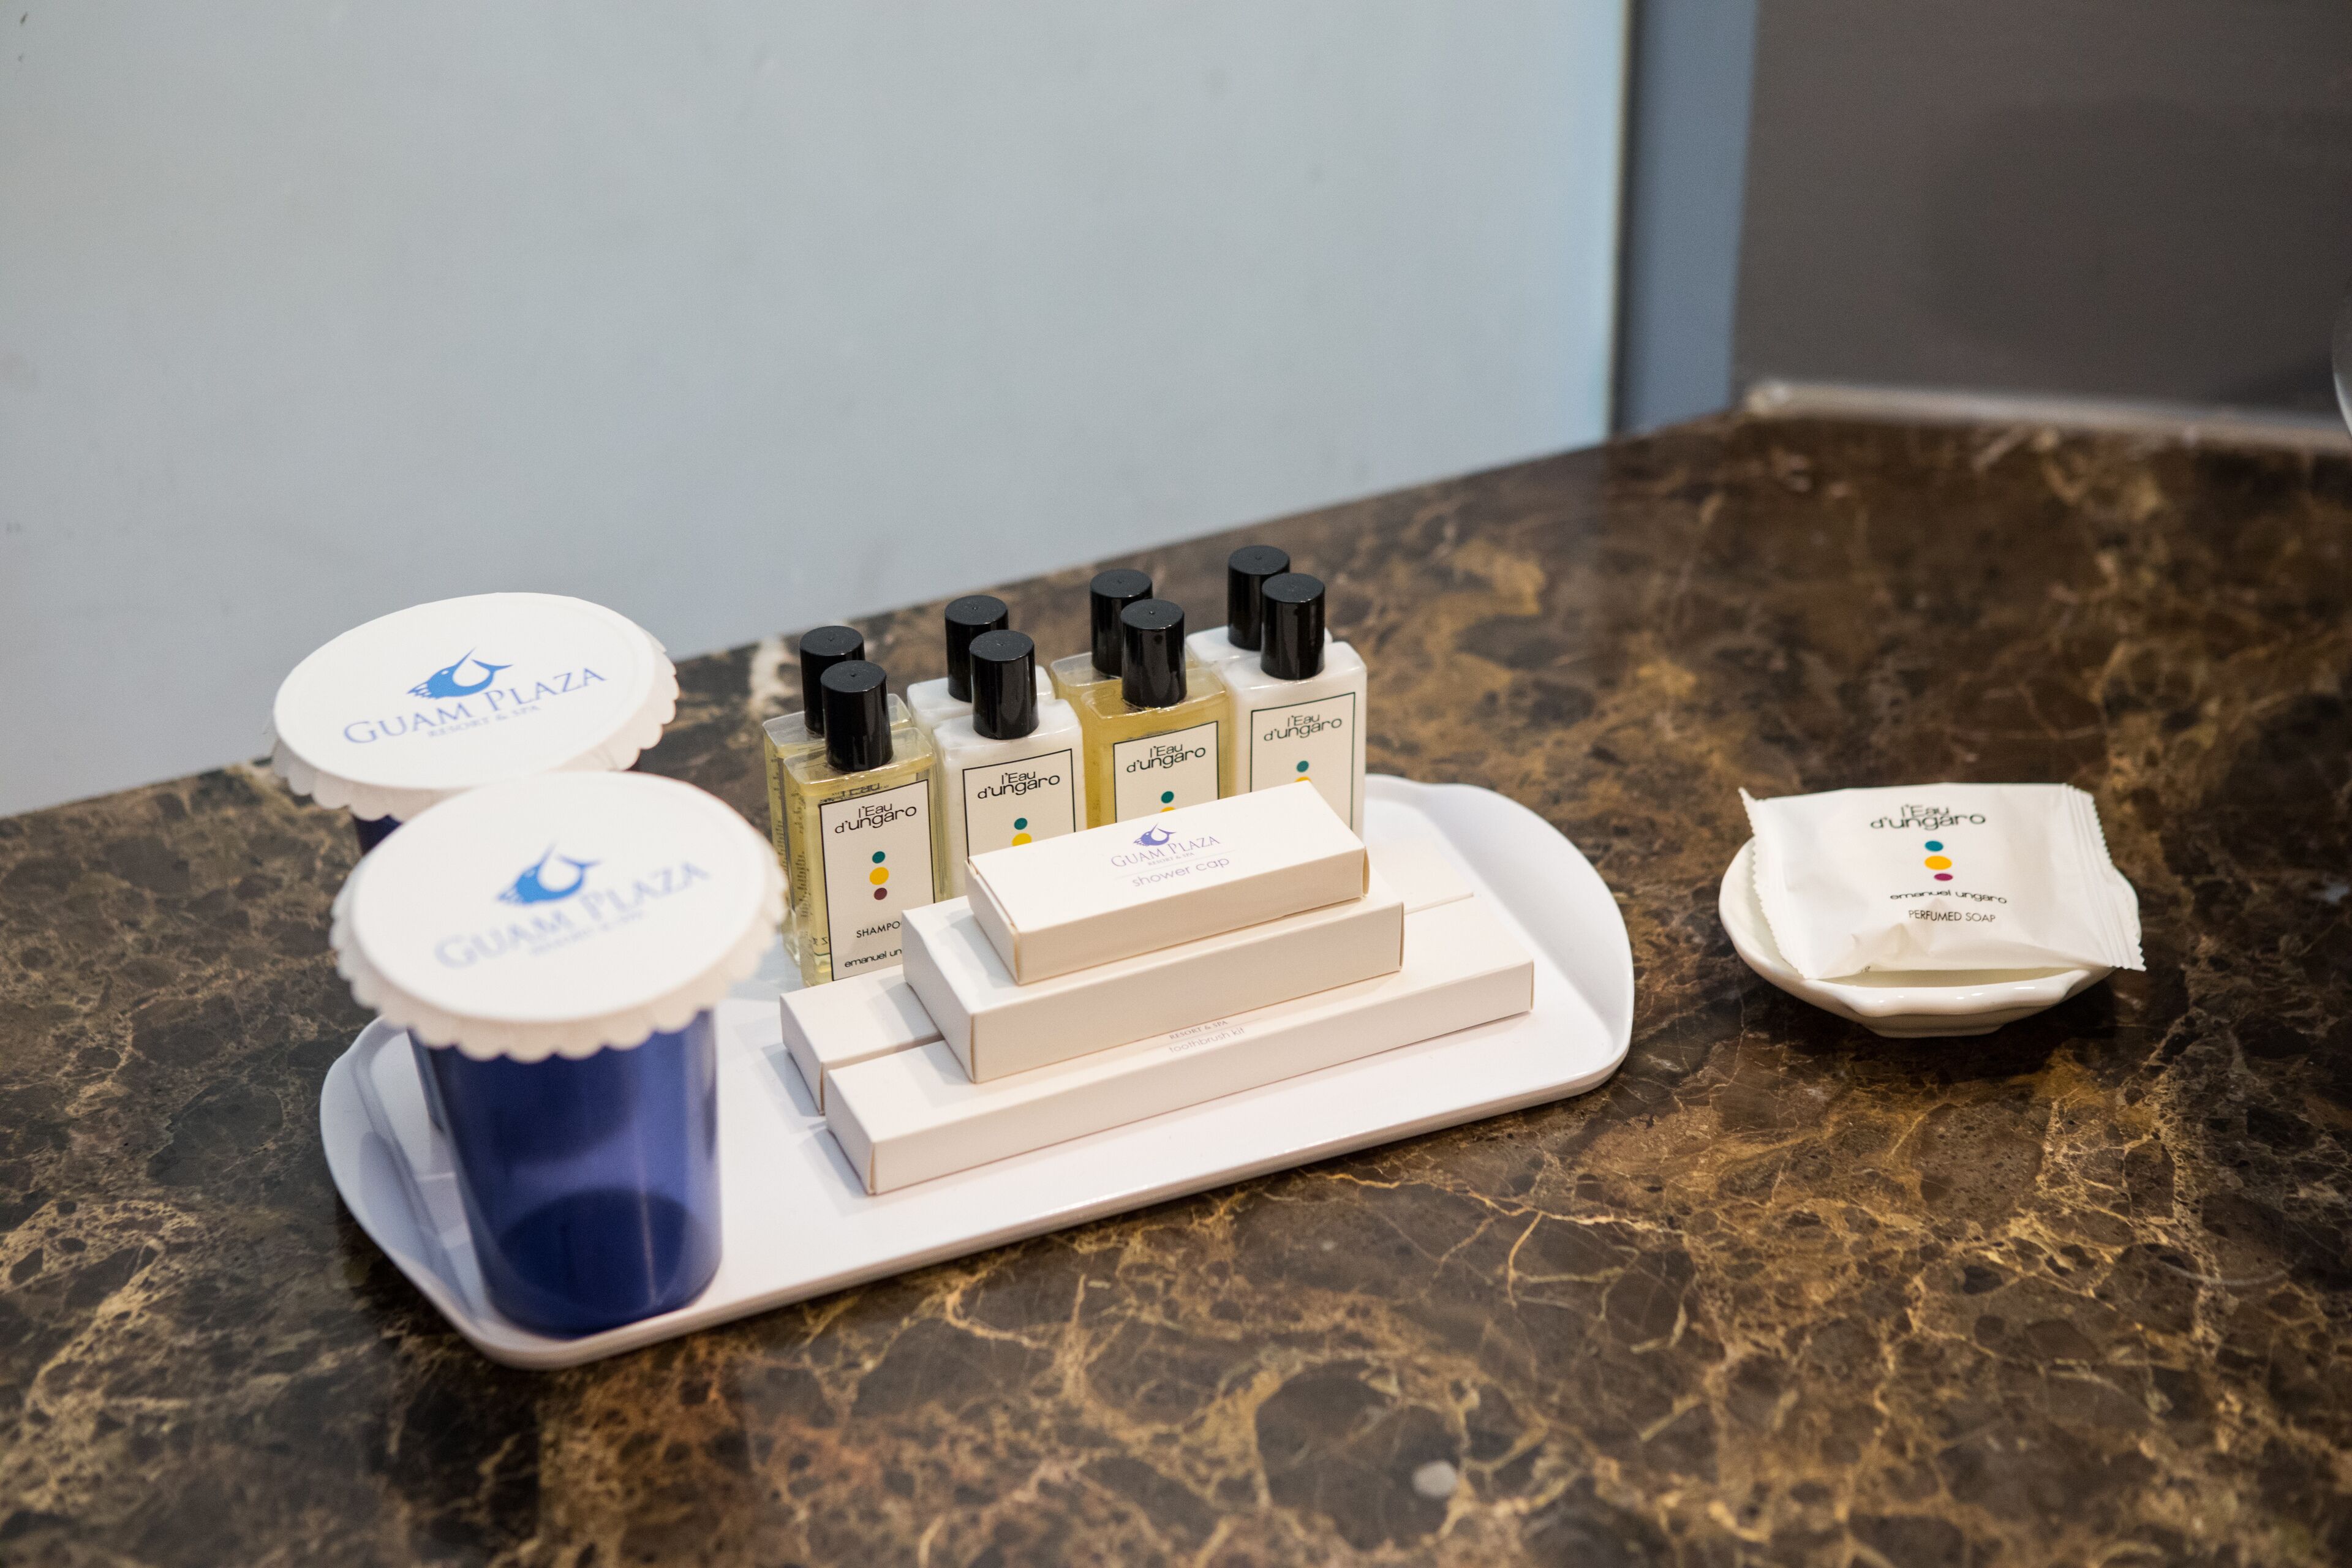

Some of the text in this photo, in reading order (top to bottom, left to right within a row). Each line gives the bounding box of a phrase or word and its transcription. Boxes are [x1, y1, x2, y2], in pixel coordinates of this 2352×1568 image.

[344, 667, 607, 744] GUAM PLAZA
[1287, 714, 1320, 727] l'Eau
[1264, 718, 1343, 741] d'ungaro
[1150, 744, 1183, 758] l'Eau
[1126, 747, 1206, 773] d'ungaro
[1001, 771, 1036, 785] l'Eau
[977, 775, 1060, 799] d'ungaro
[858, 803, 892, 818] l'Eau
[1901, 804, 1950, 817] l'Eau
[834, 806, 917, 834] d'ungaro
[1870, 813, 1986, 831] d'ungaro
[1111, 836, 1221, 867] GUAM PLAZA
[1132, 858, 1230, 888] shower cap
[1890, 889, 2007, 904] emanuel ungaro
[434, 910, 574, 968] GUAM
[579, 862, 711, 921] PLAZA
[1909, 910, 1996, 923] PERFUMED SOAP
[856, 921, 902, 938] SHAMPO
[845, 951, 888, 968] emanuel
[1169, 1027, 1202, 1039] RESORT
[1169, 1027, 1246, 1053] toothbrush kit
